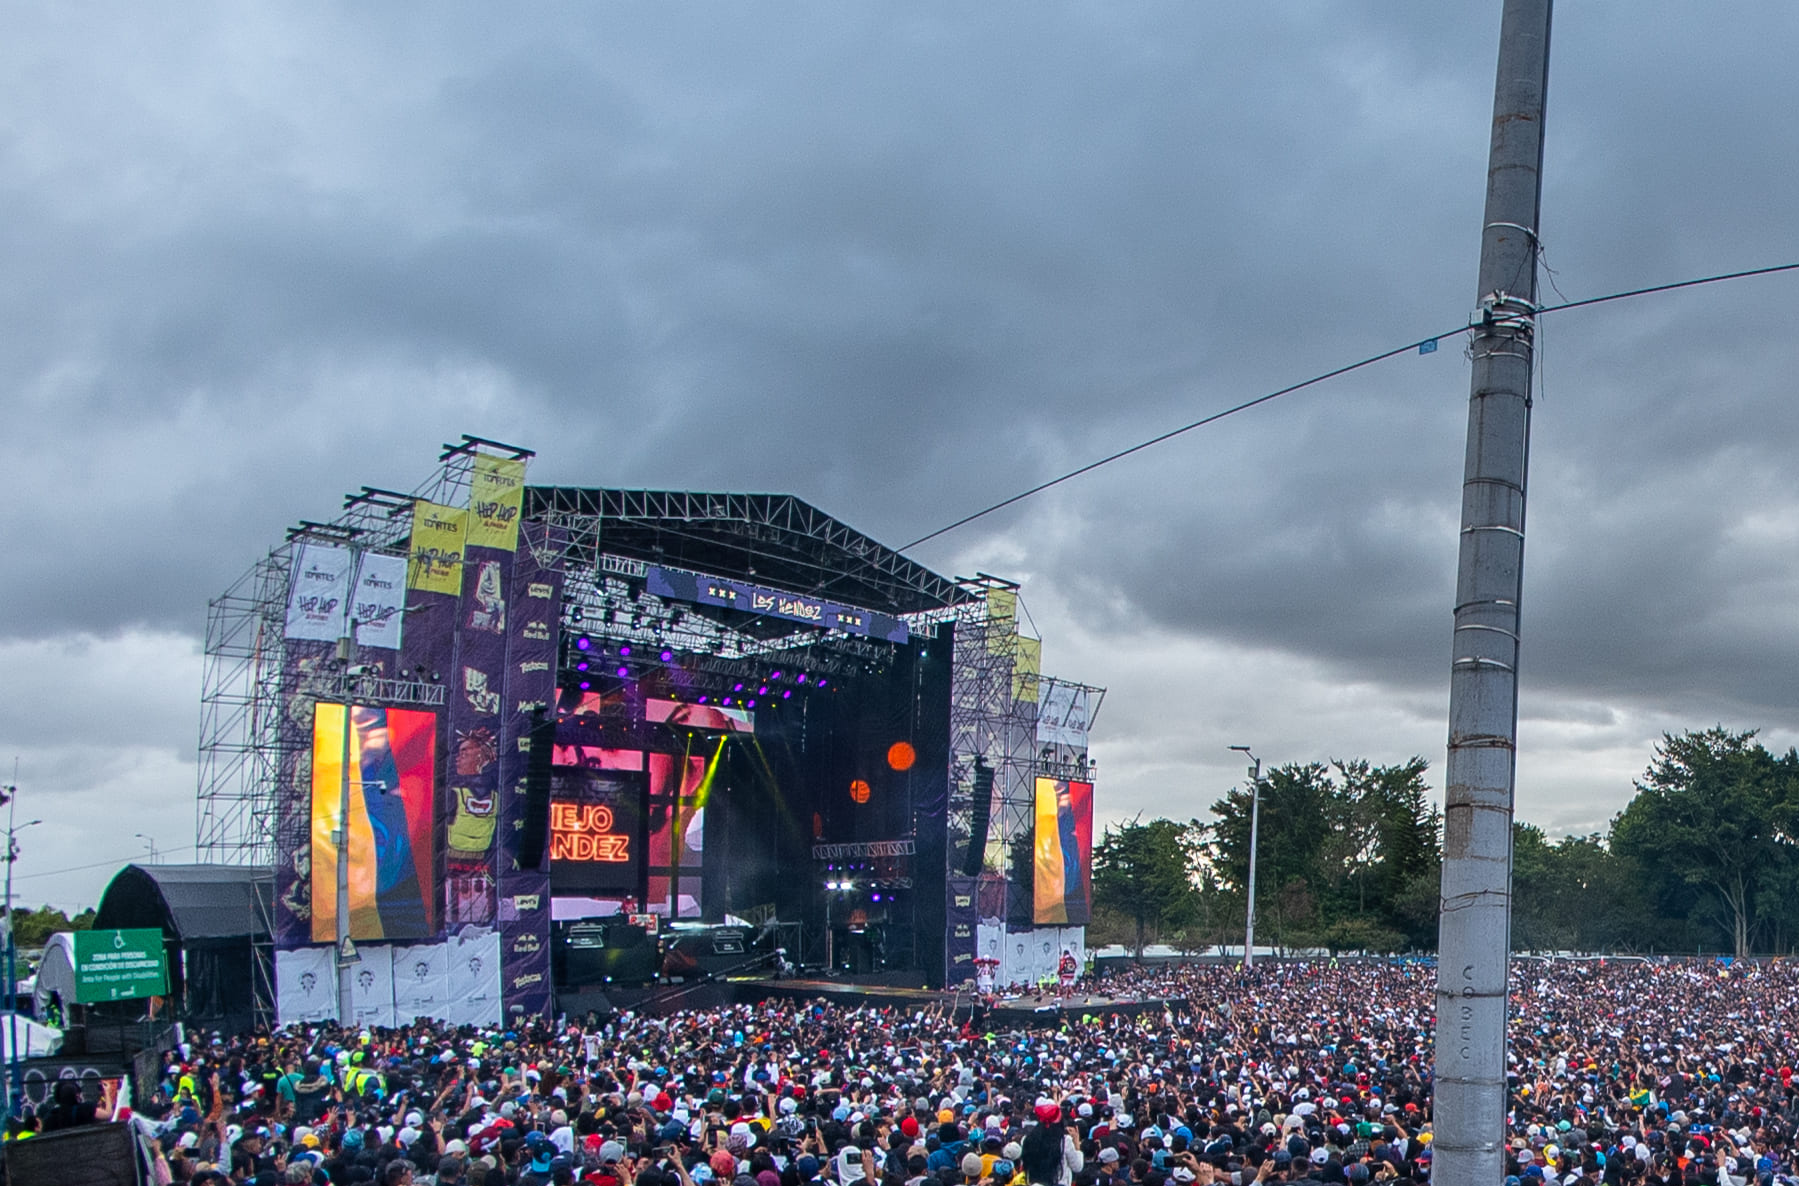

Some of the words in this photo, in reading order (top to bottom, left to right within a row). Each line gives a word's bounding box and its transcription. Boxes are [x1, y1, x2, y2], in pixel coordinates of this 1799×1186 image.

[477, 501, 498, 519] HIP
[497, 503, 518, 522] HOP
[299, 596, 319, 612] HIP
[319, 597, 338, 614] HOP
[358, 603, 376, 619] HIP
